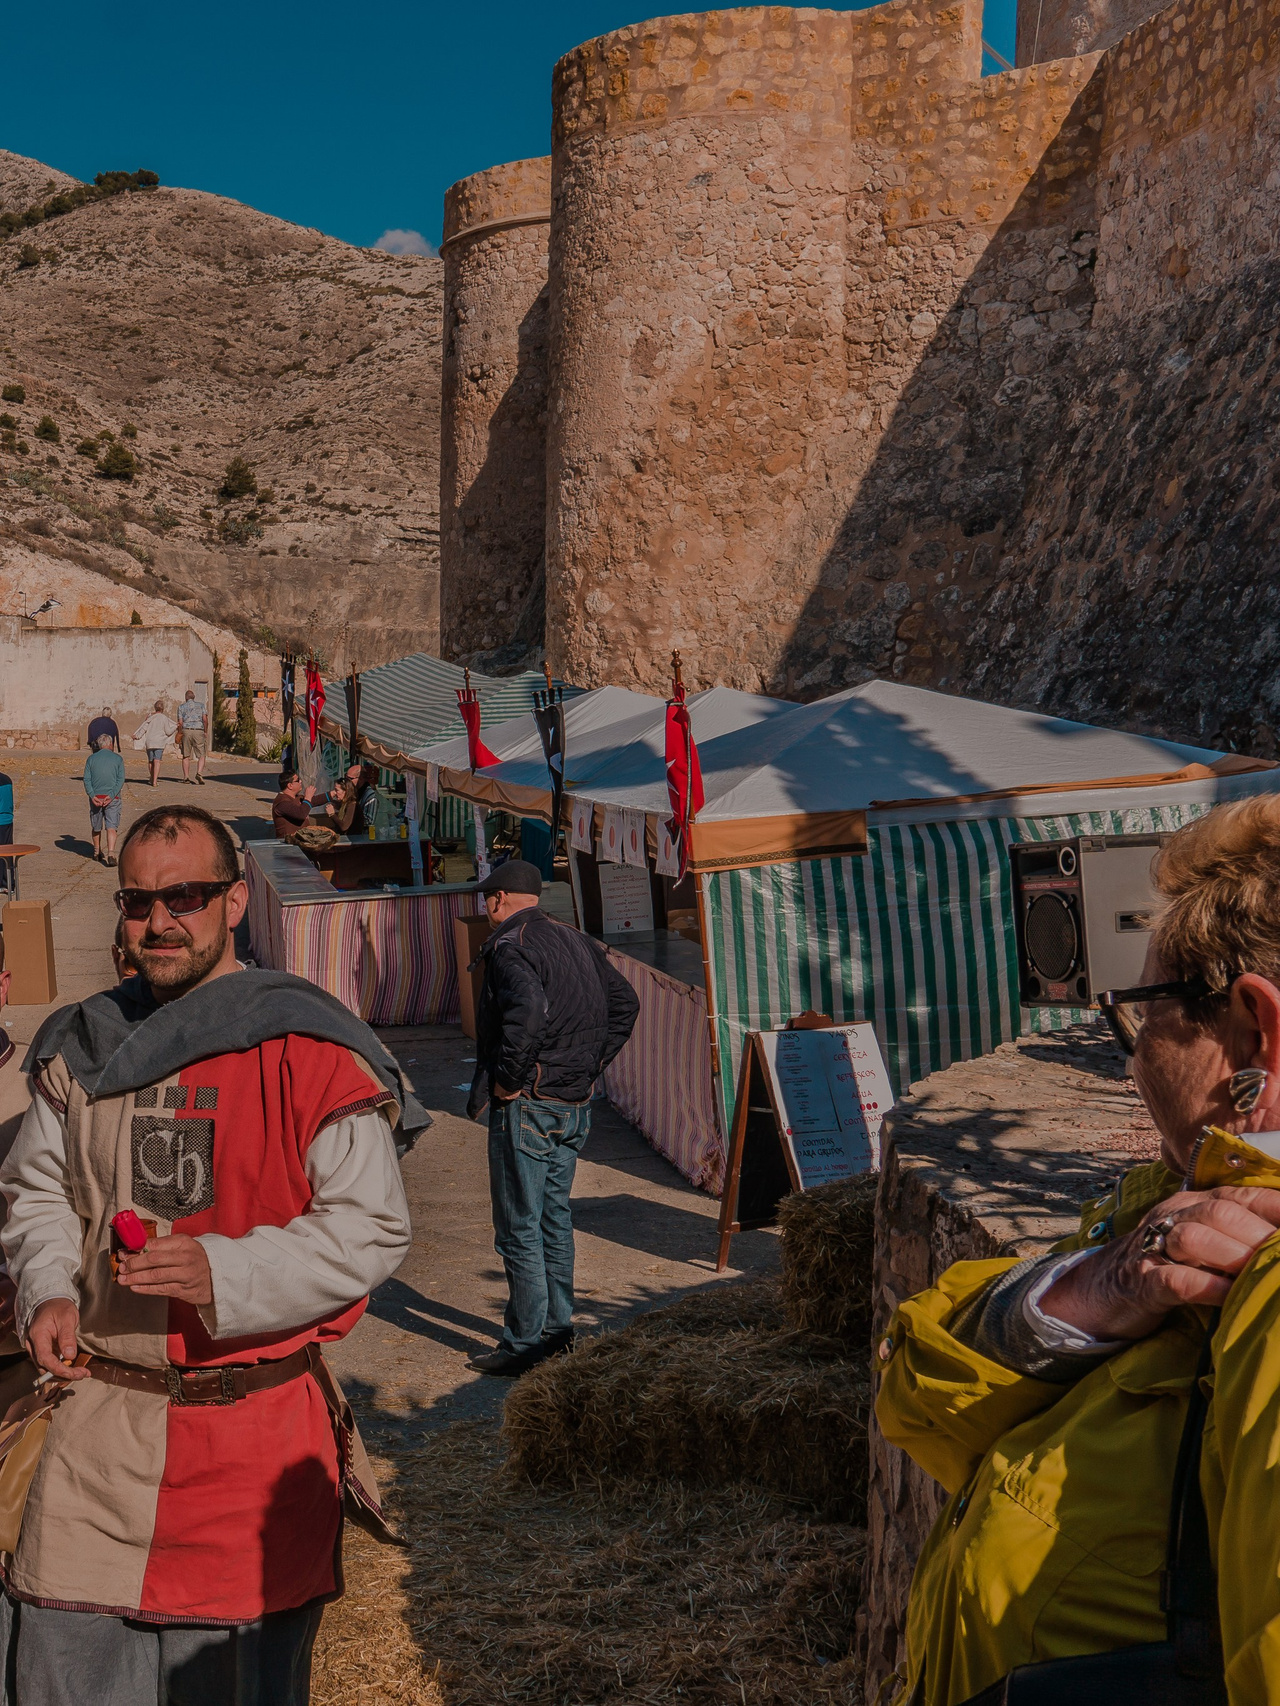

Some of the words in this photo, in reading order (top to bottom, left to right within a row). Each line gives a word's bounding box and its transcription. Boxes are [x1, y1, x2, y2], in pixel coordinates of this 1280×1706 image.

[776, 1032, 800, 1042] VINOS
[828, 1028, 859, 1039] VARIOS
[833, 1050, 868, 1062] CERVEZA
[836, 1069, 876, 1083] REFRESCOS
[851, 1090, 873, 1099] AGUA
[802, 1137, 835, 1147] COMIDAS
[796, 1149, 817, 1159] PARA
[817, 1147, 845, 1158] GRUPOS
[138, 1129, 205, 1205] Ch
